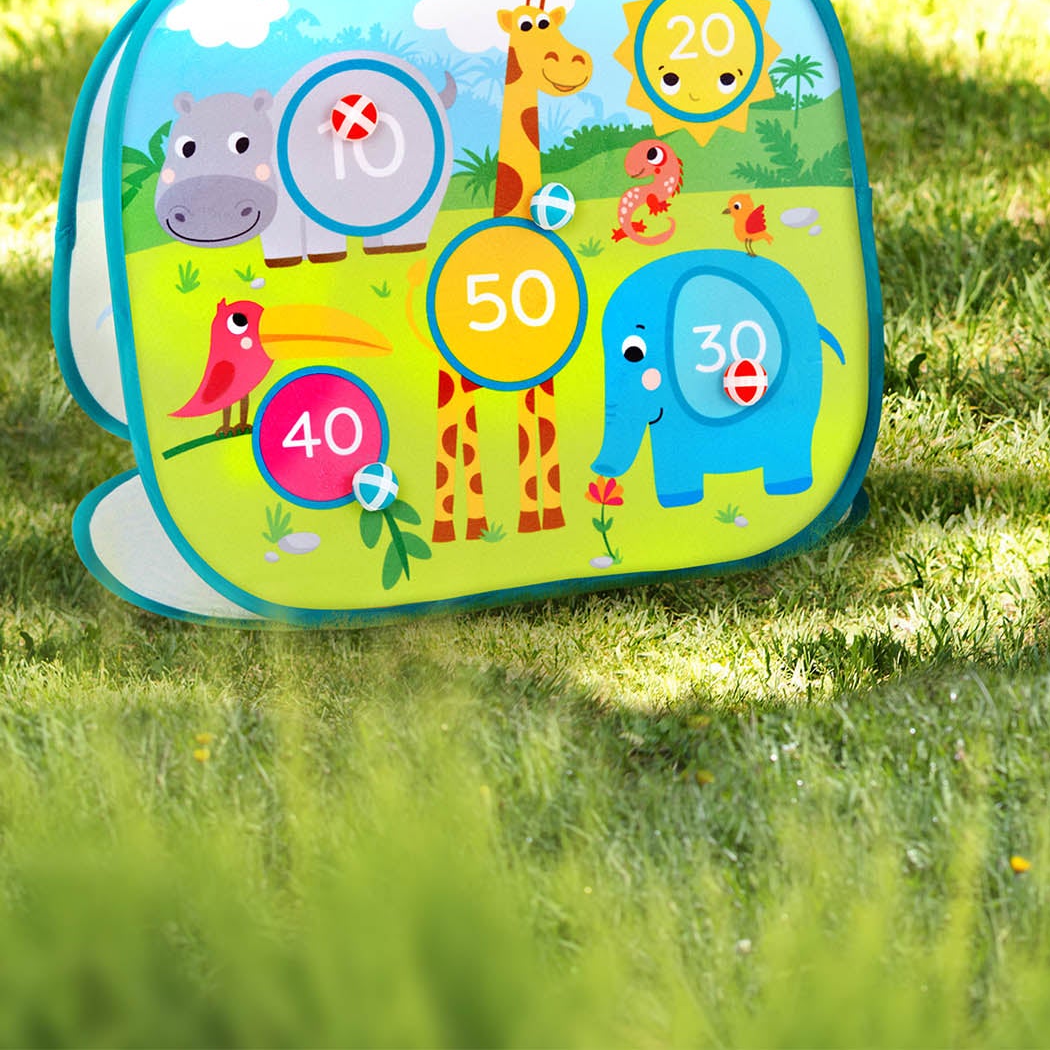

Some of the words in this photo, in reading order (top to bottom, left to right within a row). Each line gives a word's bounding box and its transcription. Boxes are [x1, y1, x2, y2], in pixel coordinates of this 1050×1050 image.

[666, 12, 735, 60] 20
[318, 112, 405, 180] 10
[465, 270, 555, 331] 50
[692, 321, 766, 373] 30
[281, 406, 363, 458] 40
